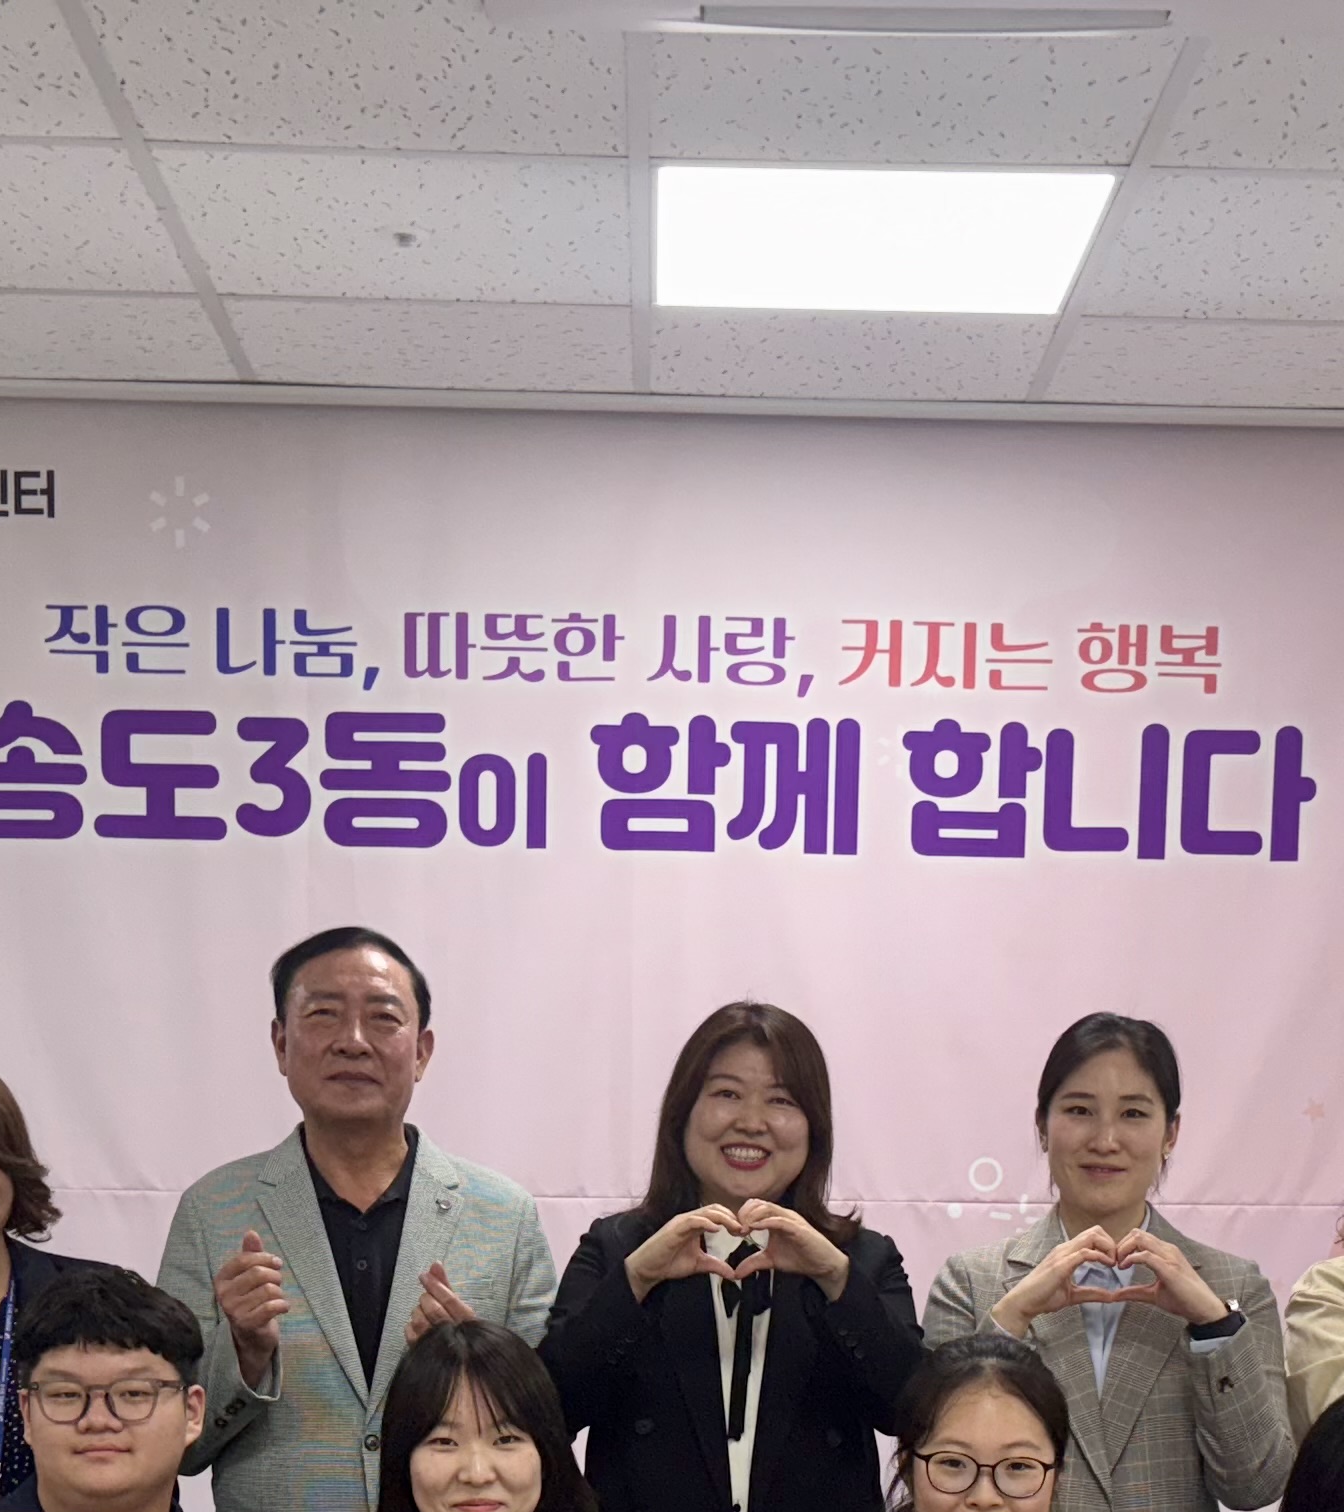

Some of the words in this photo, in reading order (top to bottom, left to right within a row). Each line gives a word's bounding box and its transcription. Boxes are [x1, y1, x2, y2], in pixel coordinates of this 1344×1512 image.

[44, 604, 190, 674] 작은
[216, 607, 380, 690] 나눔,
[404, 611, 624, 682] 따뜻한
[647, 614, 814, 698] 사랑,
[838, 618, 1053, 690] 커지는
[1077, 621, 1222, 694] 행복
[590, 712, 860, 855] 함께
[902, 718, 1316, 861] 합니다
